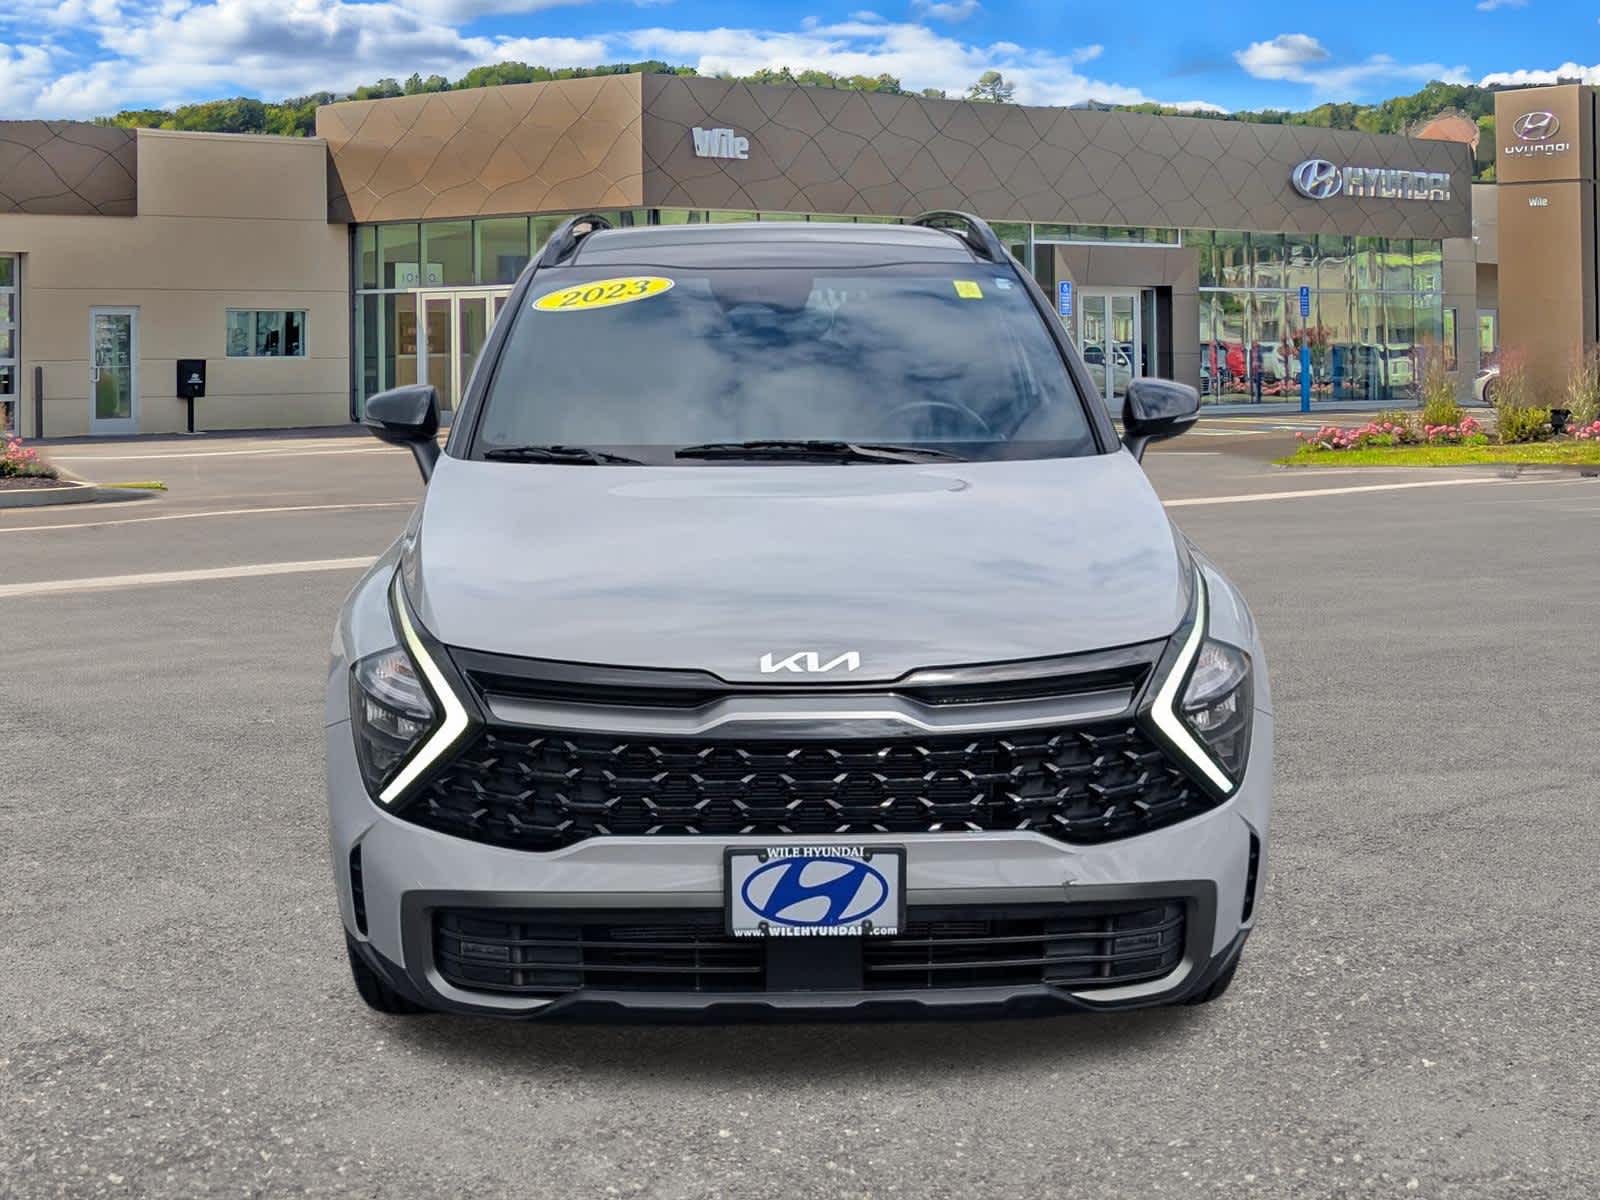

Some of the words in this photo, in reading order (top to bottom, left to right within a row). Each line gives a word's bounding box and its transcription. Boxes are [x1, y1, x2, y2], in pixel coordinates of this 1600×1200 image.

[691, 127, 750, 160] Wile
[1342, 167, 1452, 201] HYUNDAI
[1528, 197, 1549, 207] Wile
[559, 279, 652, 308] 2023
[760, 651, 860, 673] KIA
[767, 847, 800, 858] WILE
[803, 846, 864, 857] HYUNDAI
[769, 926, 862, 936] WILEHYUNDAI
